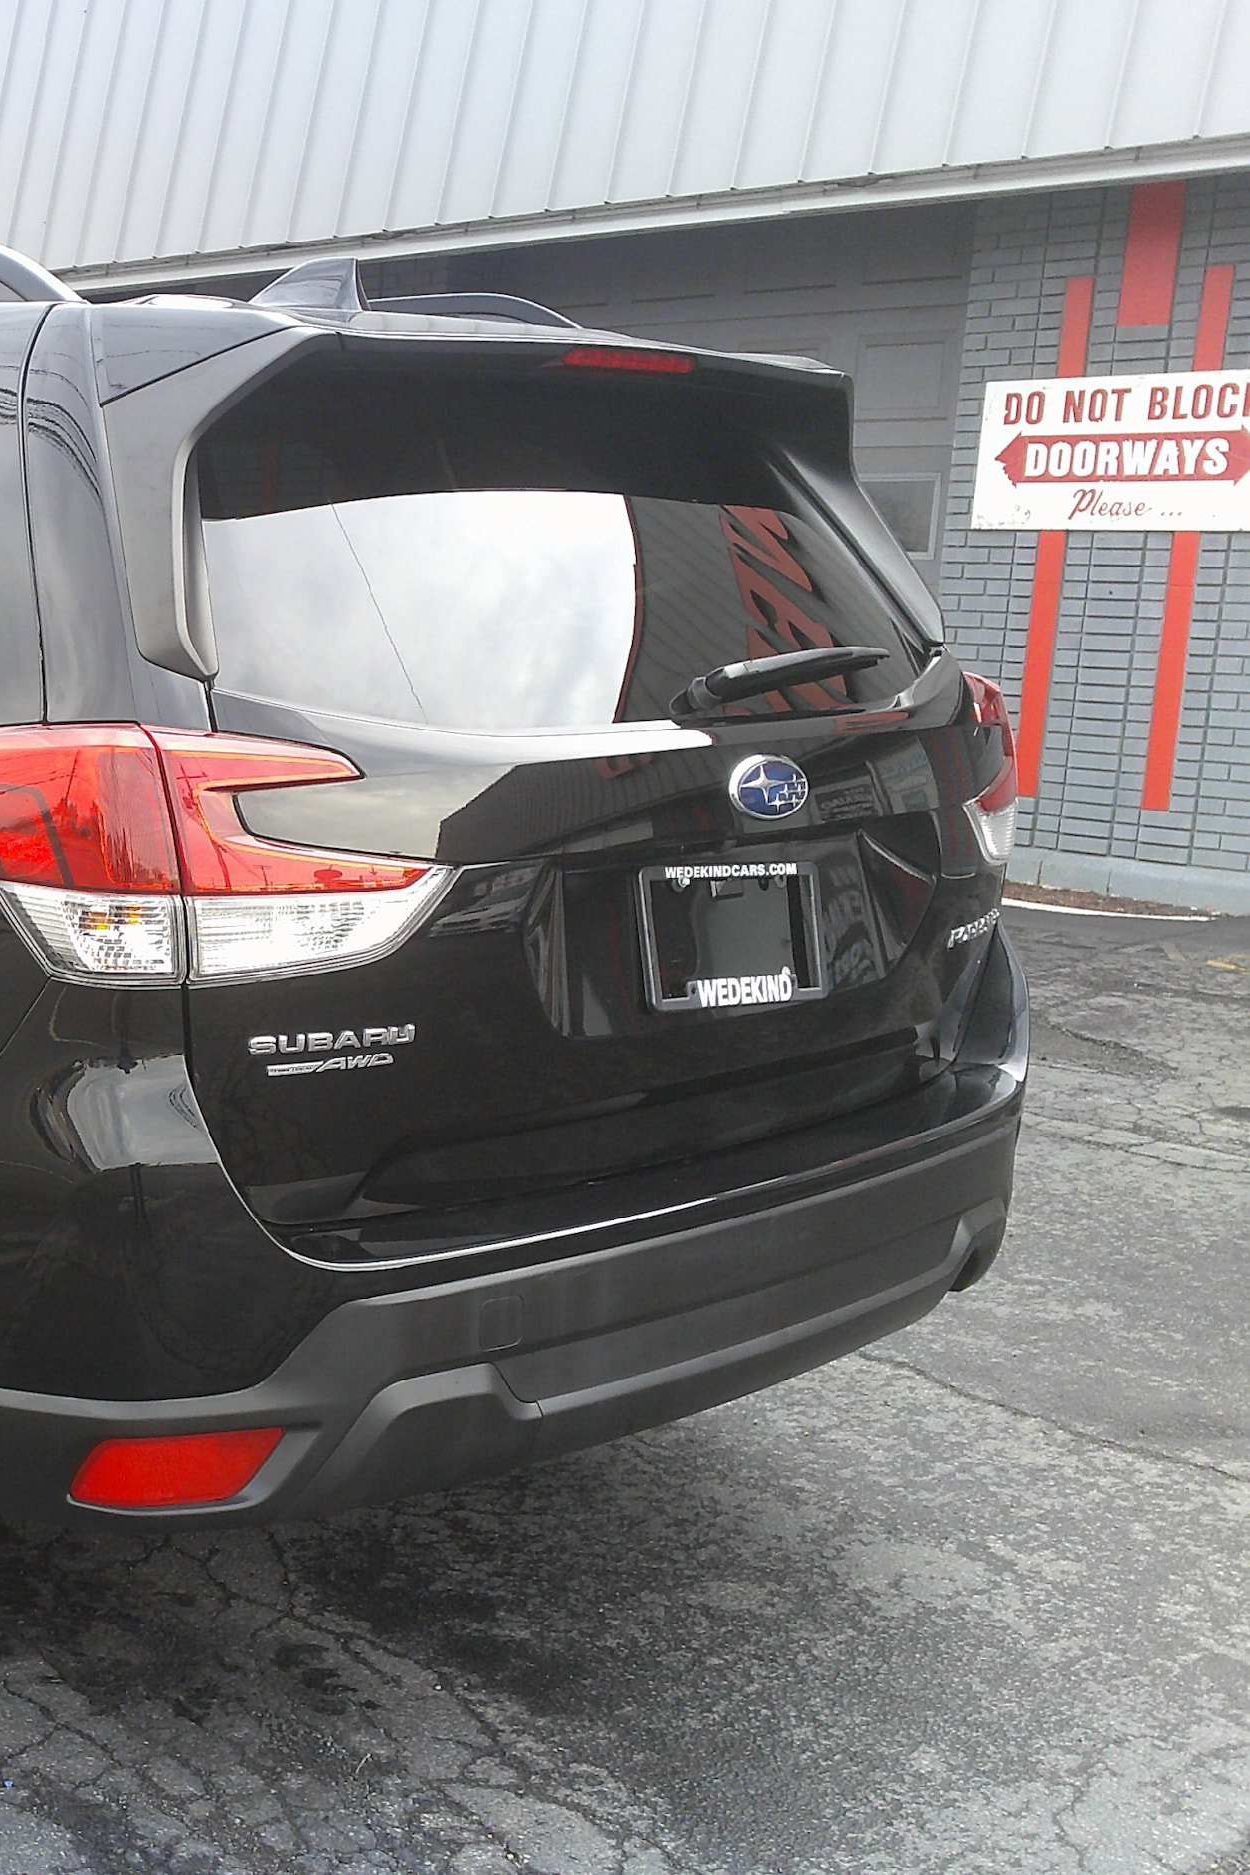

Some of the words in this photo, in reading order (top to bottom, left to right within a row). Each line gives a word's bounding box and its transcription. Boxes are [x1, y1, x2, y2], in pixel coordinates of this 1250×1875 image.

[1003, 391, 1046, 425] DO
[1062, 388, 1132, 423] NOT
[1023, 438, 1230, 477] DOORWAYS
[1068, 488, 1152, 520] Please
[665, 863, 798, 878] WEDEKINDCARS.COM
[697, 974, 792, 1008] WEDEKIND
[248, 1023, 416, 1055] SUBARU
[316, 1053, 395, 1072] AWD
